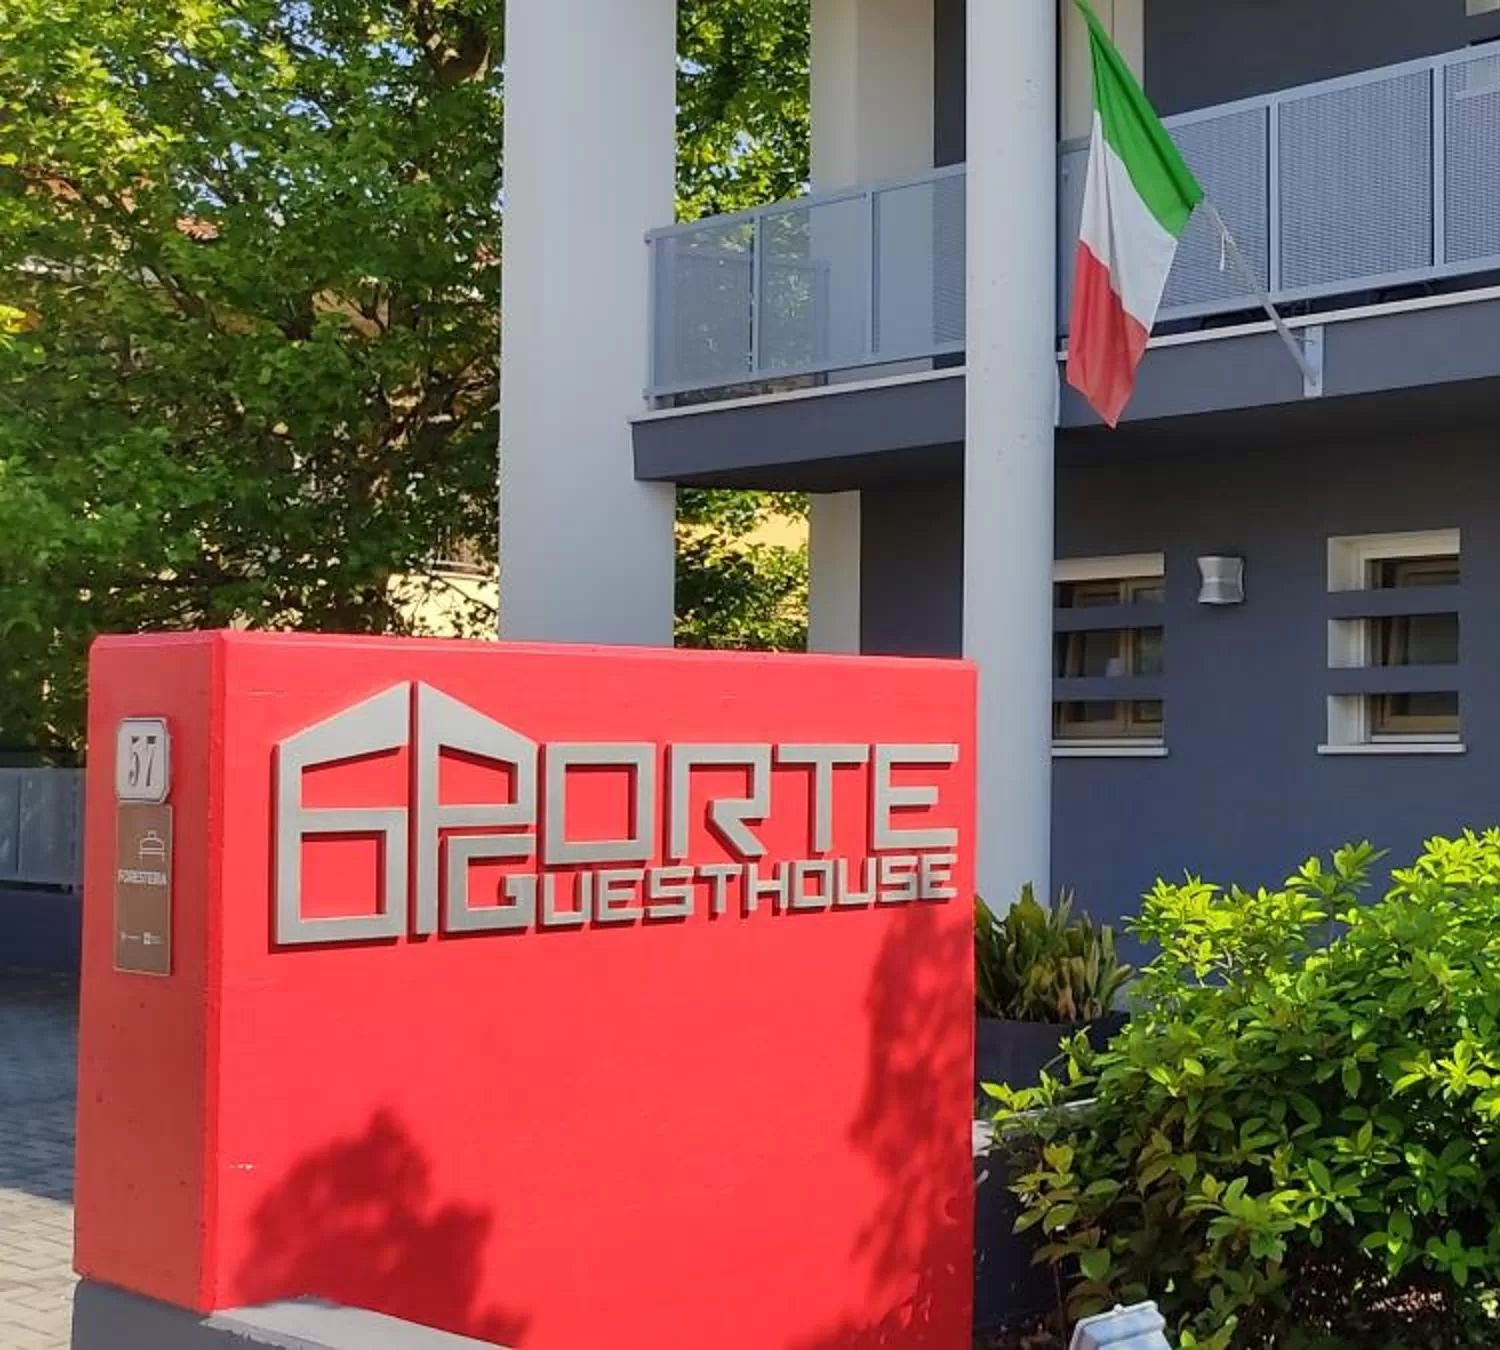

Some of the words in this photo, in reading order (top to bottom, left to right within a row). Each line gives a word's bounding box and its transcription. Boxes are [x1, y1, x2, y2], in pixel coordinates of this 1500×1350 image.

[129, 736, 157, 787] 57
[416, 680, 959, 934] PORTE
[446, 833, 958, 932] GUESTHOUSE
